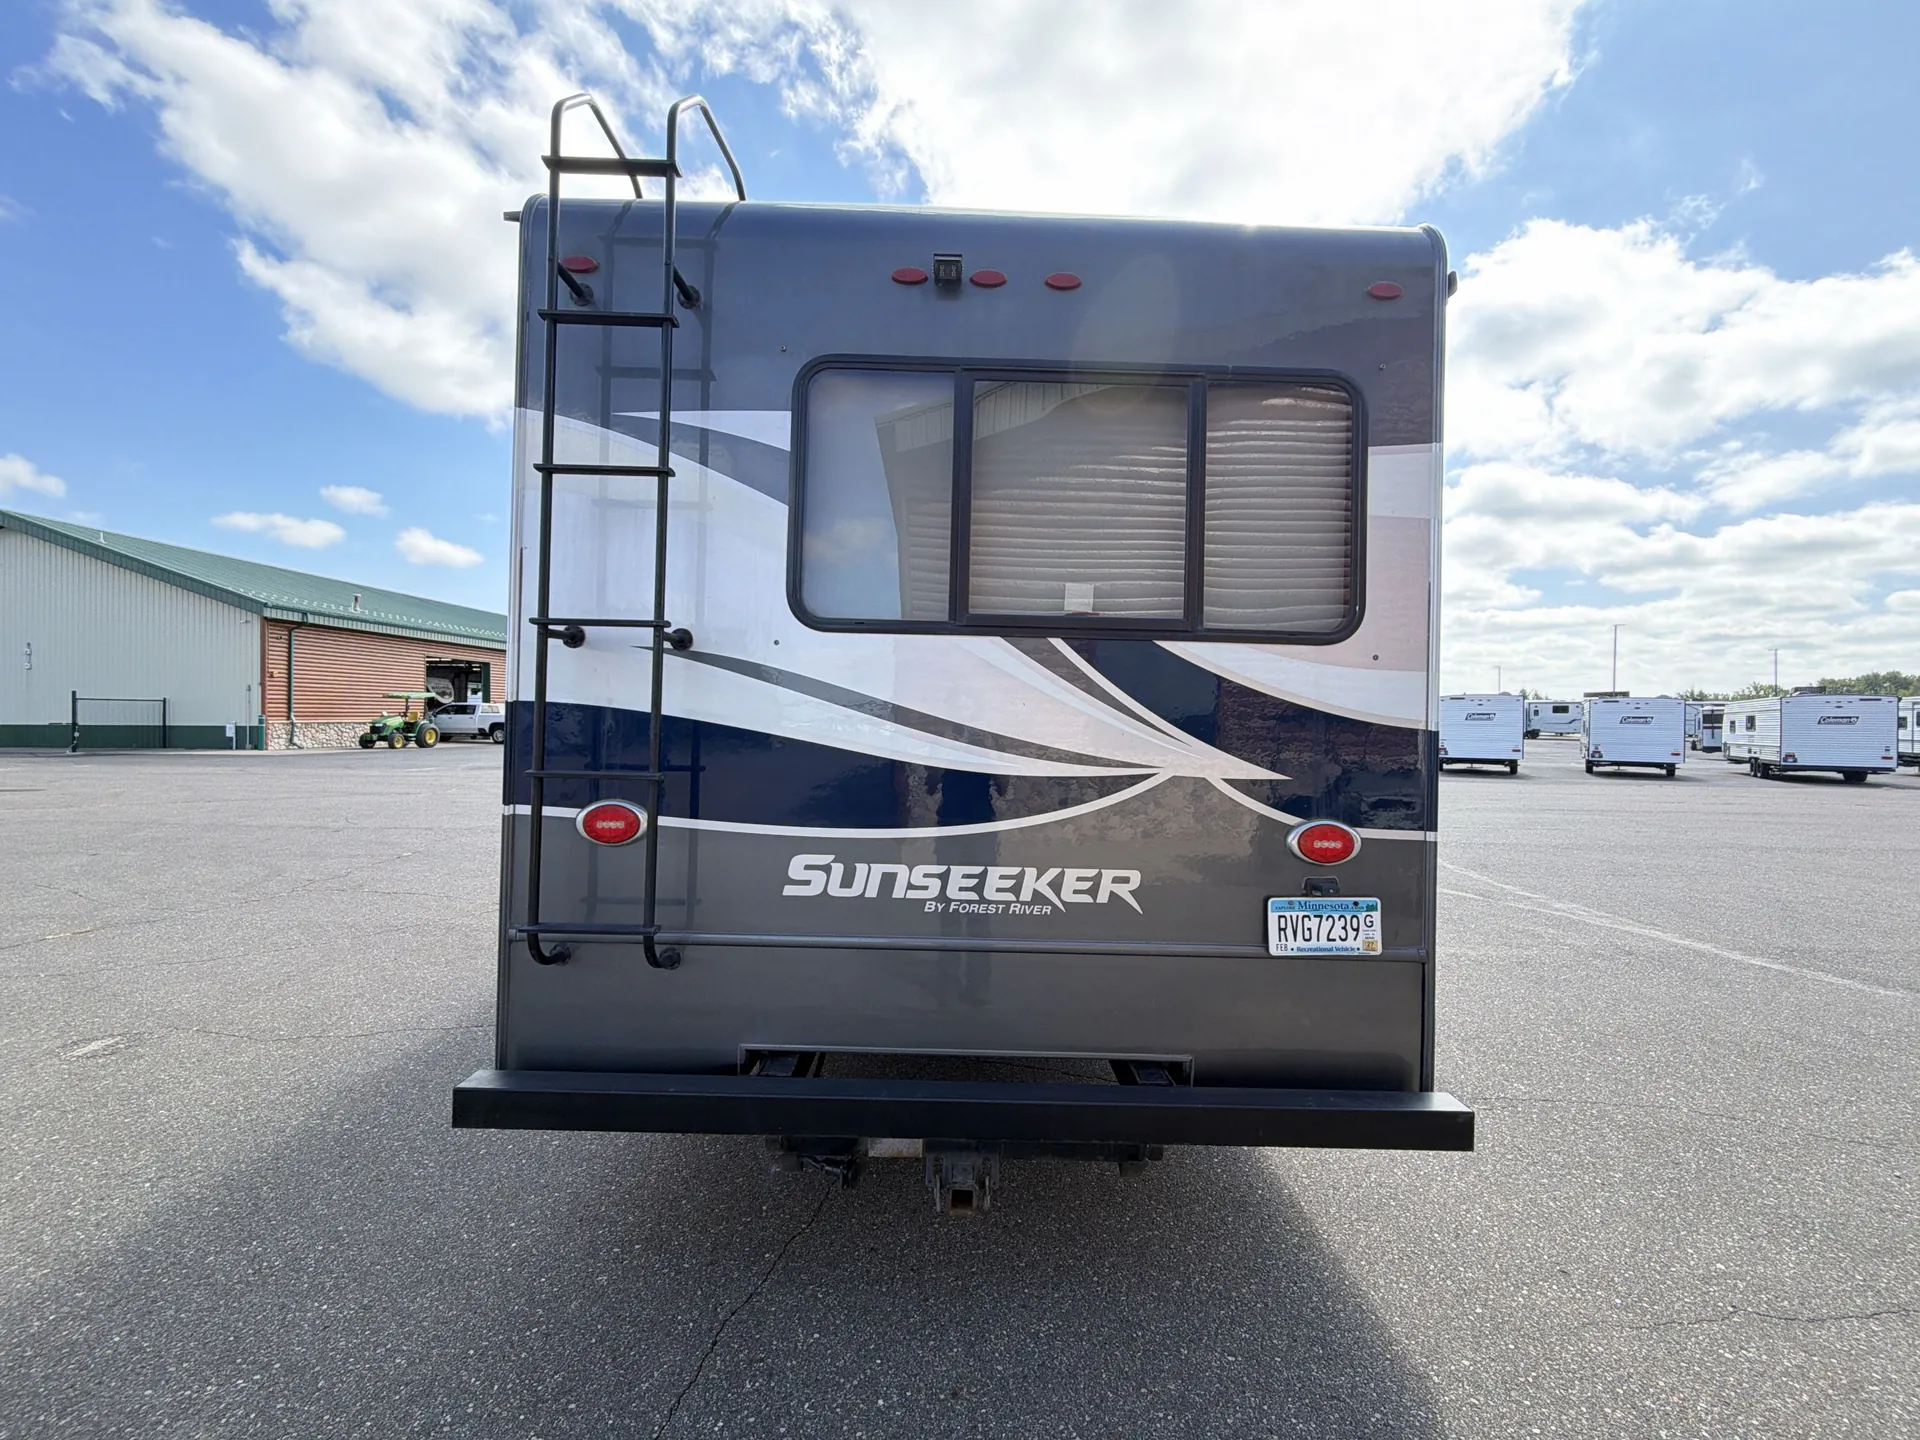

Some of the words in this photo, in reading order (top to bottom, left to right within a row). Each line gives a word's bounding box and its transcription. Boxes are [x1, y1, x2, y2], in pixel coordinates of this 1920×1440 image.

[949, 901, 1003, 914] FOREST
[1008, 903, 1052, 915] RIVER
[1298, 900, 1349, 910] Minnesota
[1277, 914, 1360, 942] RVG7239
[1364, 914, 1374, 928] G
[1276, 943, 1288, 952] FEB
